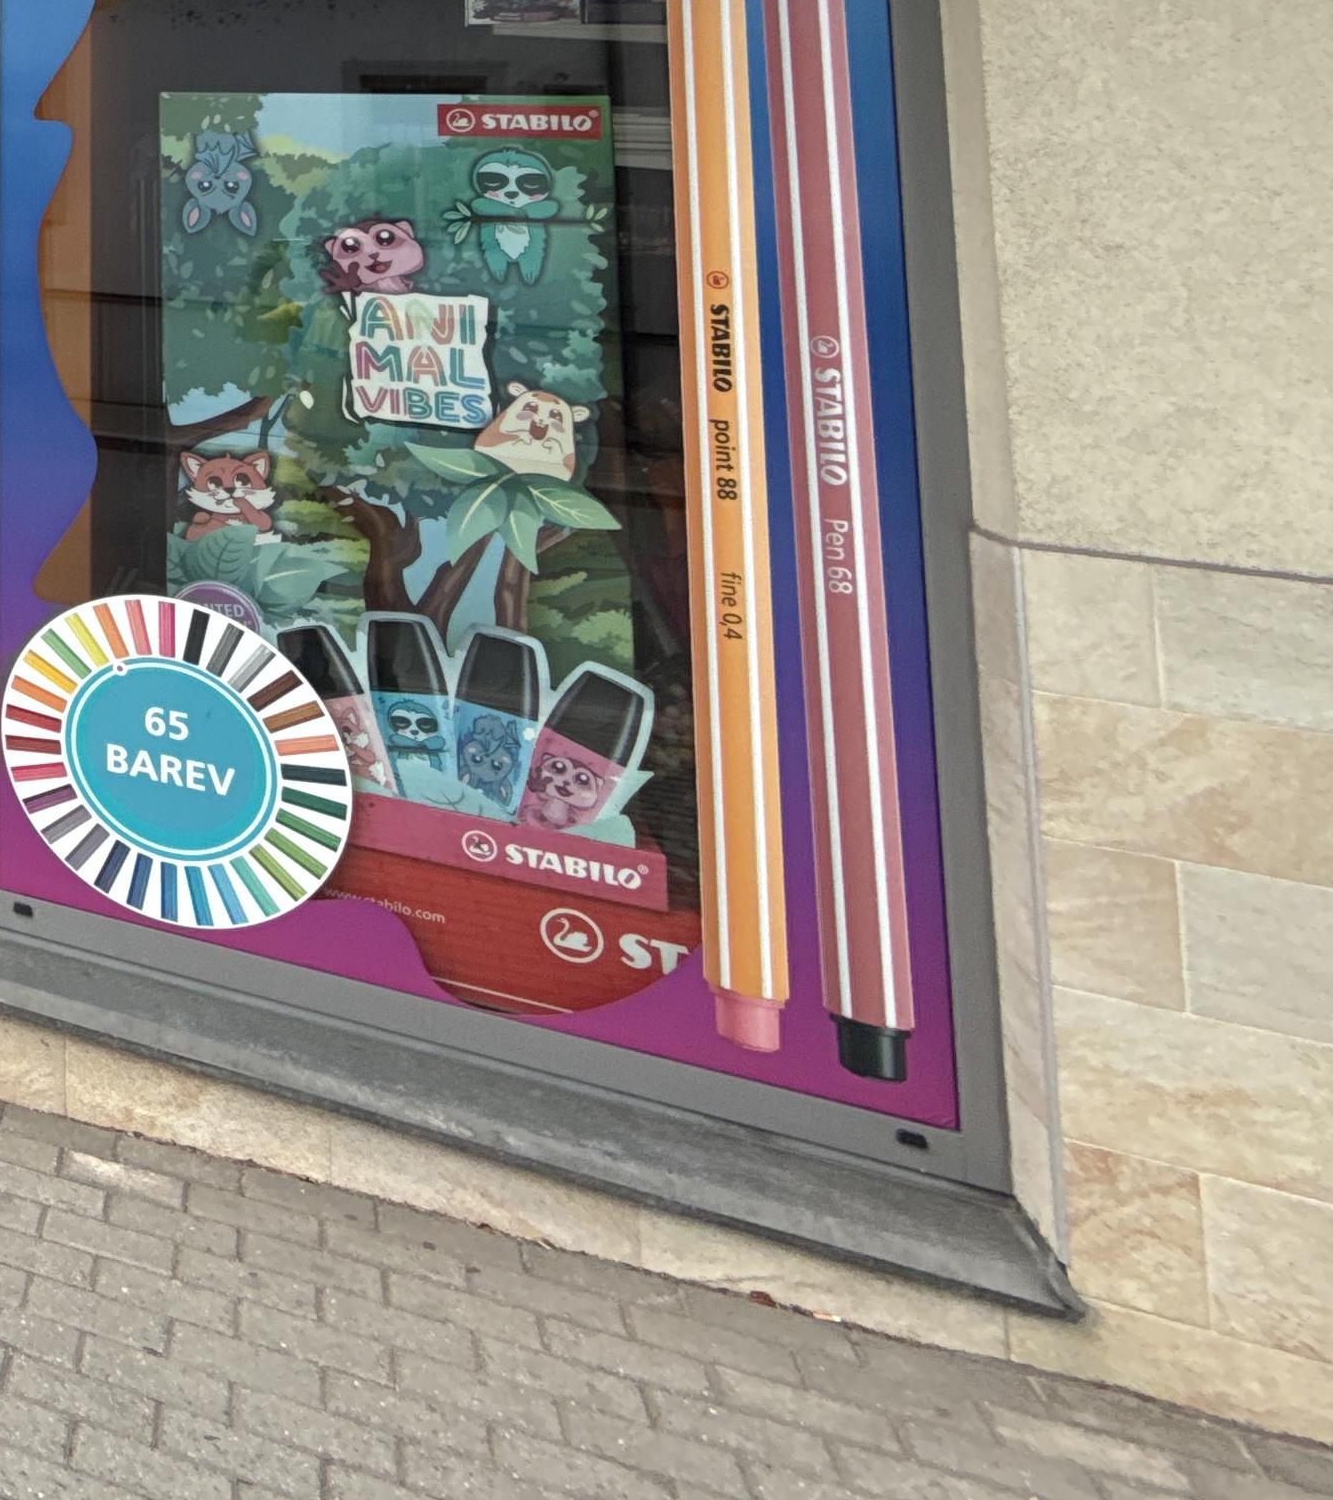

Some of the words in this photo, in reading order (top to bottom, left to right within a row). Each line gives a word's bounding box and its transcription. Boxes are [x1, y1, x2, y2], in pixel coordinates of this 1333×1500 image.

[359, 295, 477, 346] ANI
[355, 340, 486, 390] MAL
[710, 303, 733, 393] STABILO
[355, 384, 487, 425] VIBES
[813, 366, 848, 486] STABILO
[709, 419, 738, 474] point
[716, 475, 738, 501] 88
[823, 517, 849, 561] Pen
[720, 570, 743, 608] fine
[827, 564, 854, 596] 68
[722, 611, 744, 640] 0,4
[144, 706, 190, 741] 65
[106, 743, 236, 797] BAREV
